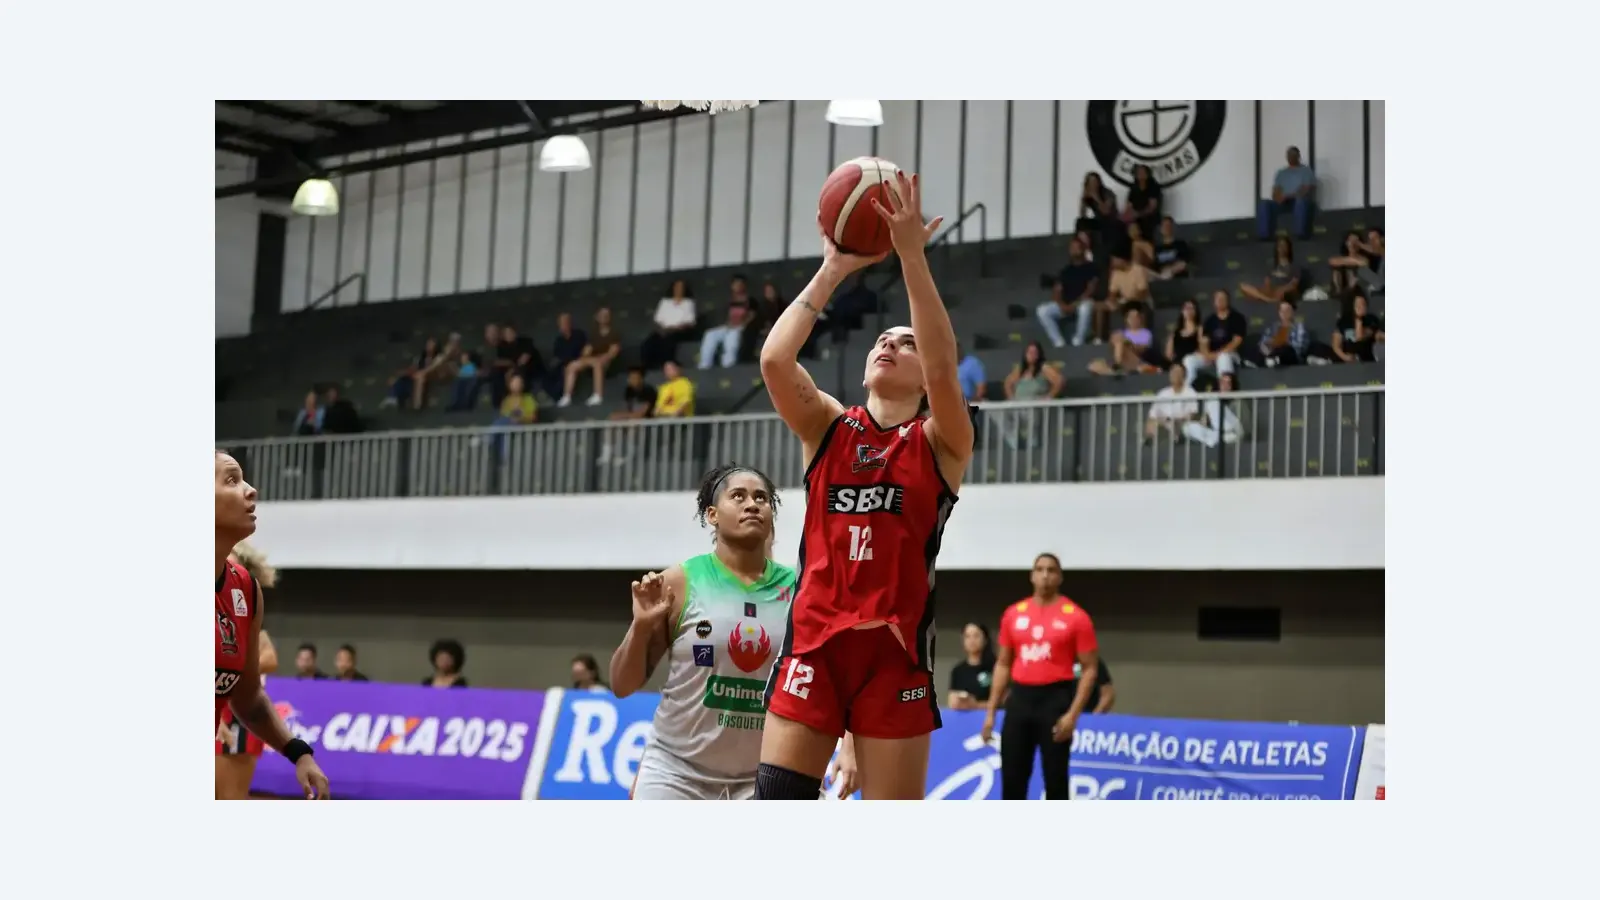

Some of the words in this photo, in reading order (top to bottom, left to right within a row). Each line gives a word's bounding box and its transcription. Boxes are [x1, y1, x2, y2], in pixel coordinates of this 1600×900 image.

[834, 486, 895, 512] SESI
[848, 525, 873, 562] 12
[712, 682, 764, 701] Unime
[782, 658, 815, 700] 12
[902, 686, 927, 702] SESI
[553, 699, 654, 791] Re
[1070, 728, 1180, 764] ORMAÇÃO
[1184, 737, 1218, 764] DE
[1219, 739, 1329, 767] ATLETAS
